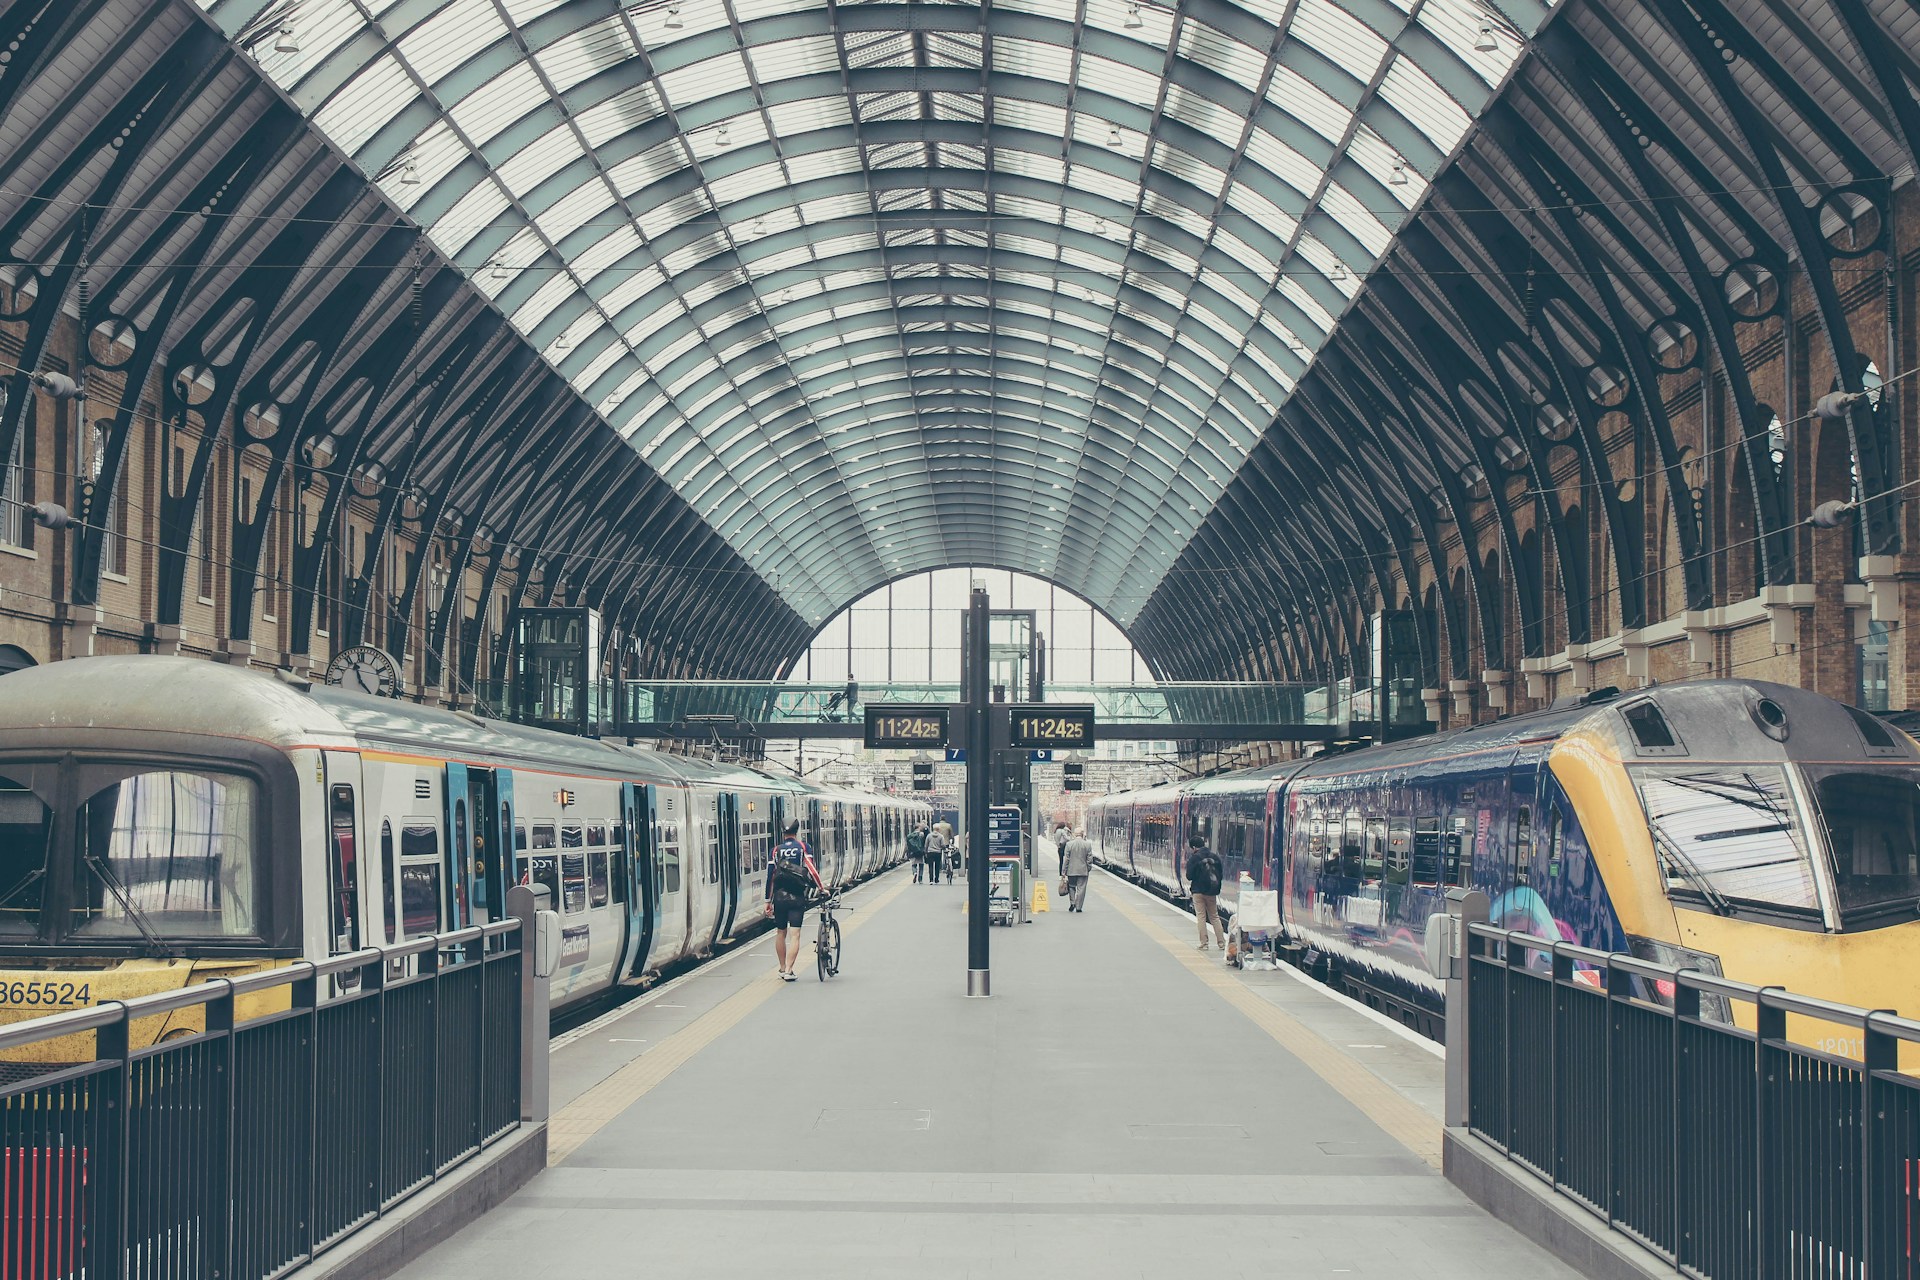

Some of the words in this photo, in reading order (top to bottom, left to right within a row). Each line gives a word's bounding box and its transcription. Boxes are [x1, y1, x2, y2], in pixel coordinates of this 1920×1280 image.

[951, 748, 960, 759] 7
[1037, 749, 1045, 759] 6
[780, 847, 799, 857] TCC
